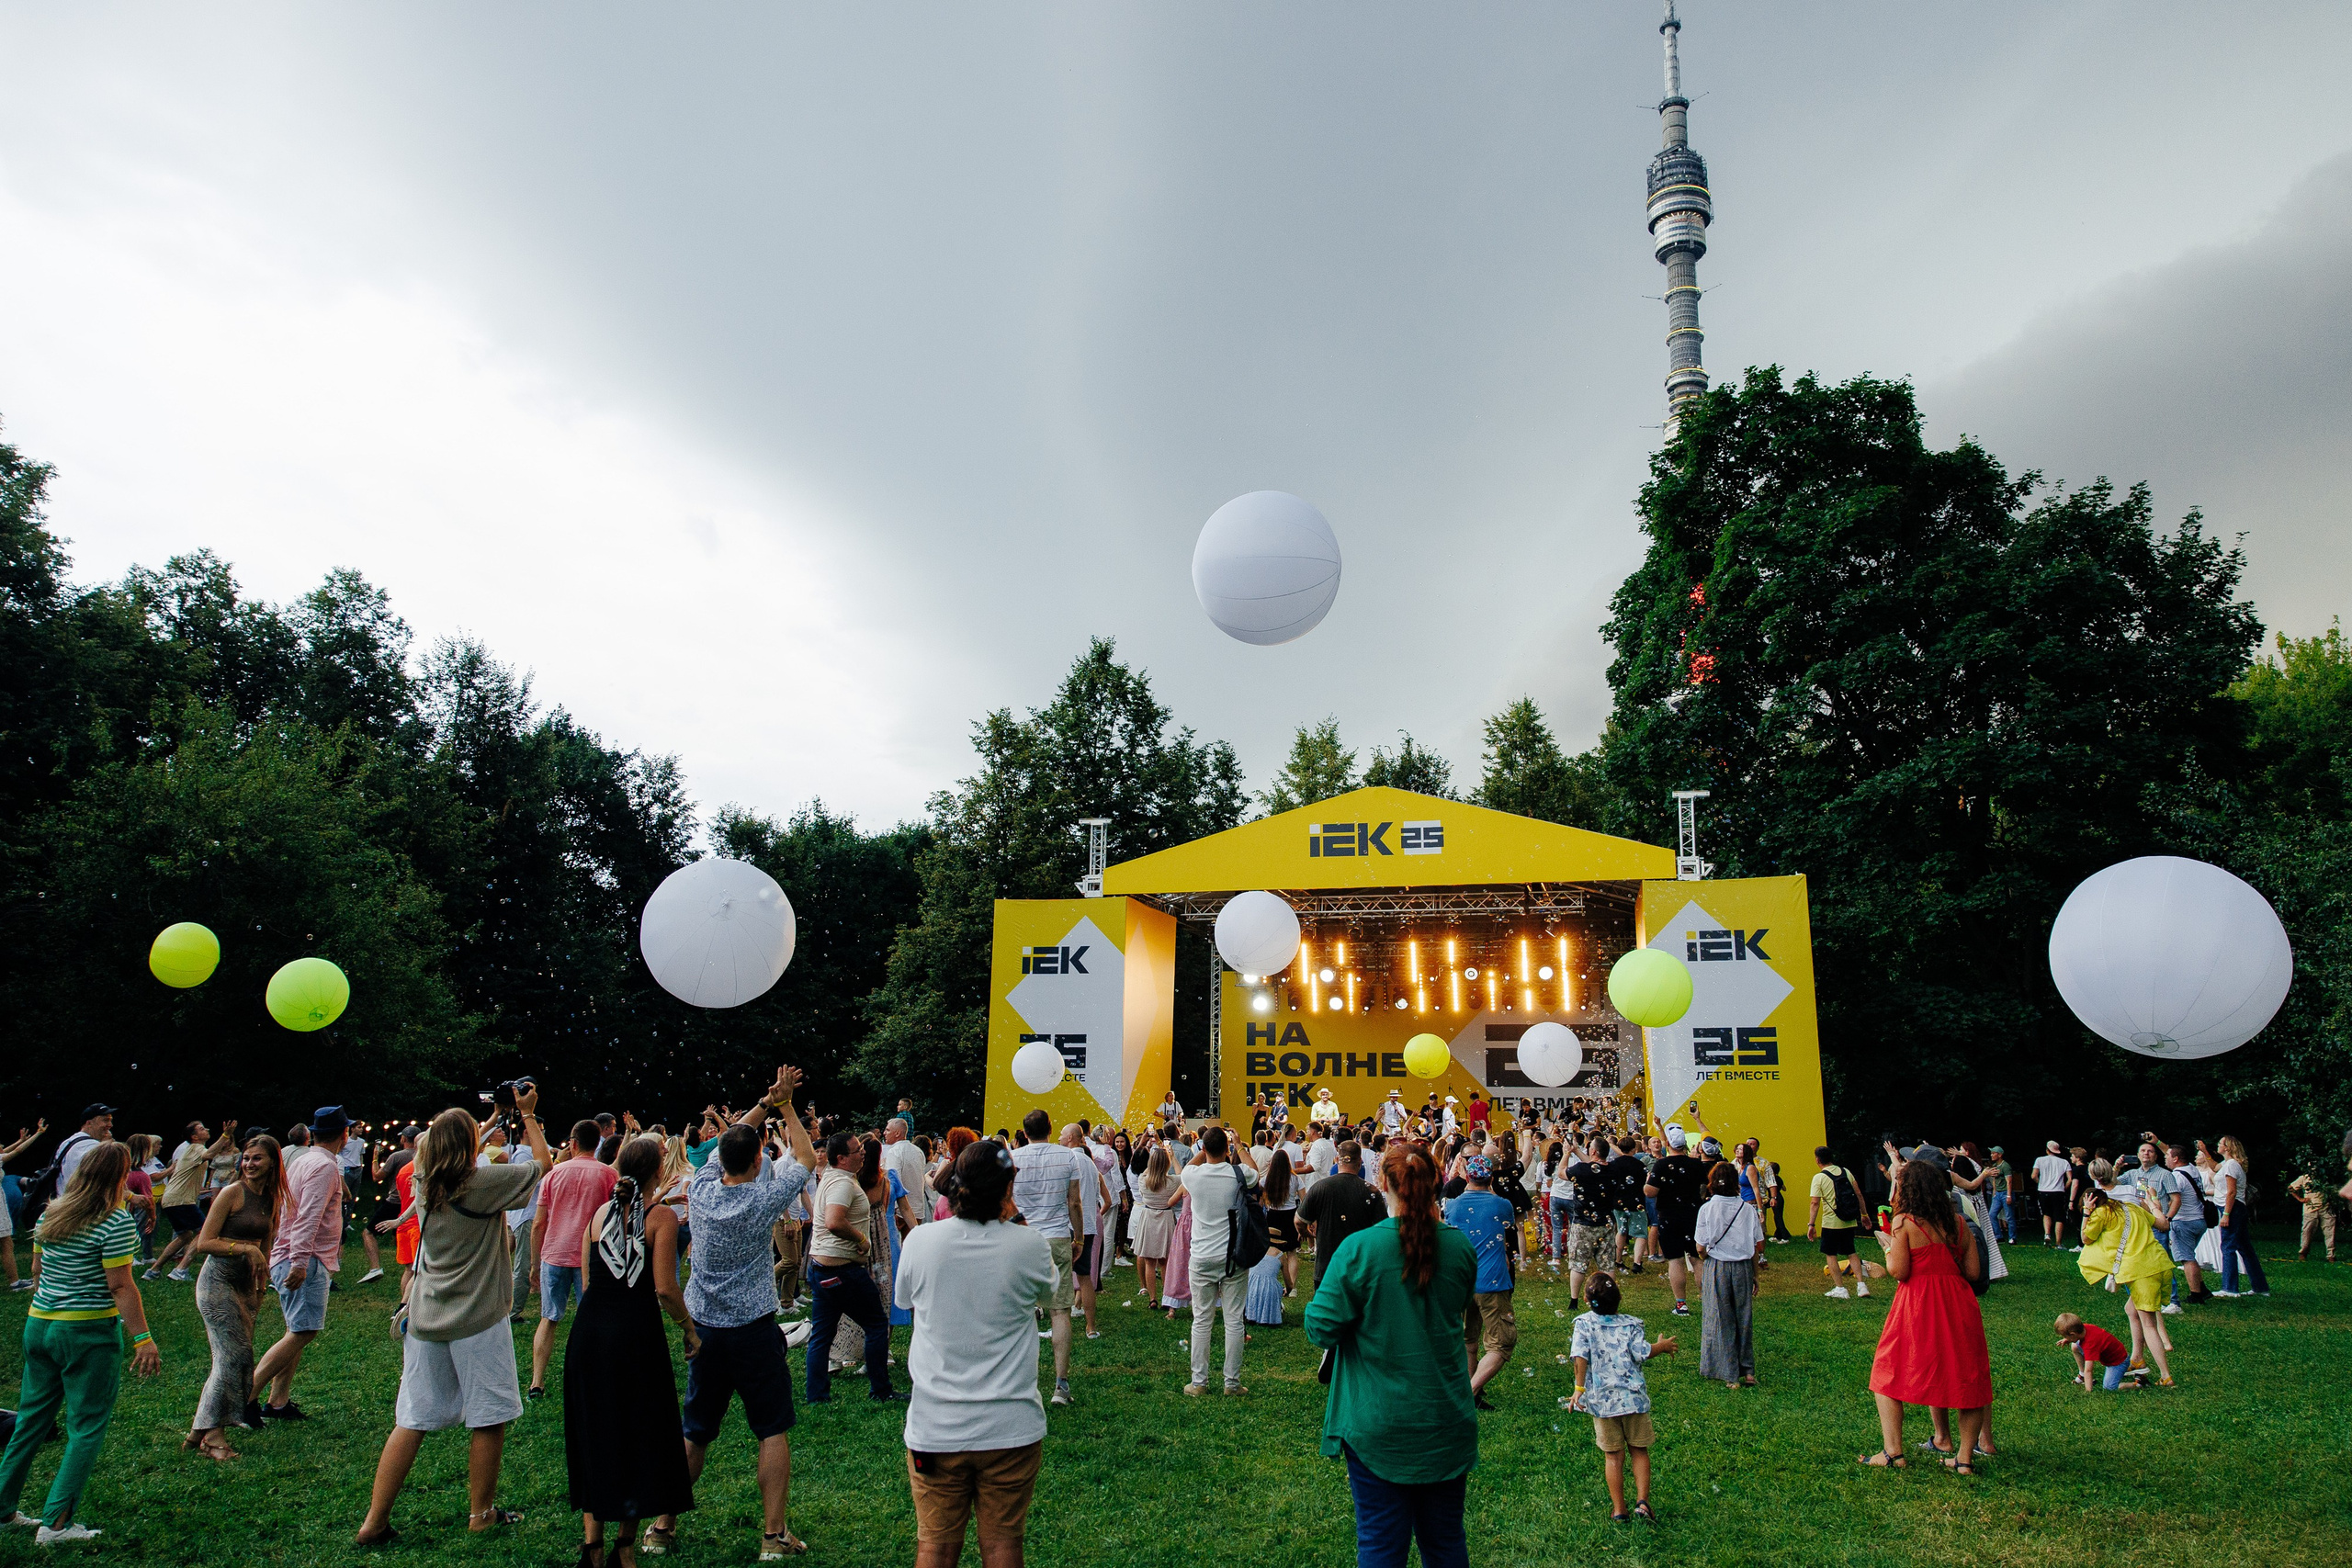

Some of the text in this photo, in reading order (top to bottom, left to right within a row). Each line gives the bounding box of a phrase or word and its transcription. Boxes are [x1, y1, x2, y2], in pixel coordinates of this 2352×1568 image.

[1400, 826, 1444, 849] 25
[1246, 1021, 1311, 1046] НА
[1692, 1027, 1780, 1066] 25
[1246, 1052, 1408, 1077] ВОЛНЕ
[1695, 1070, 1781, 1081] ЛЕТ ВМЕСТЕ
